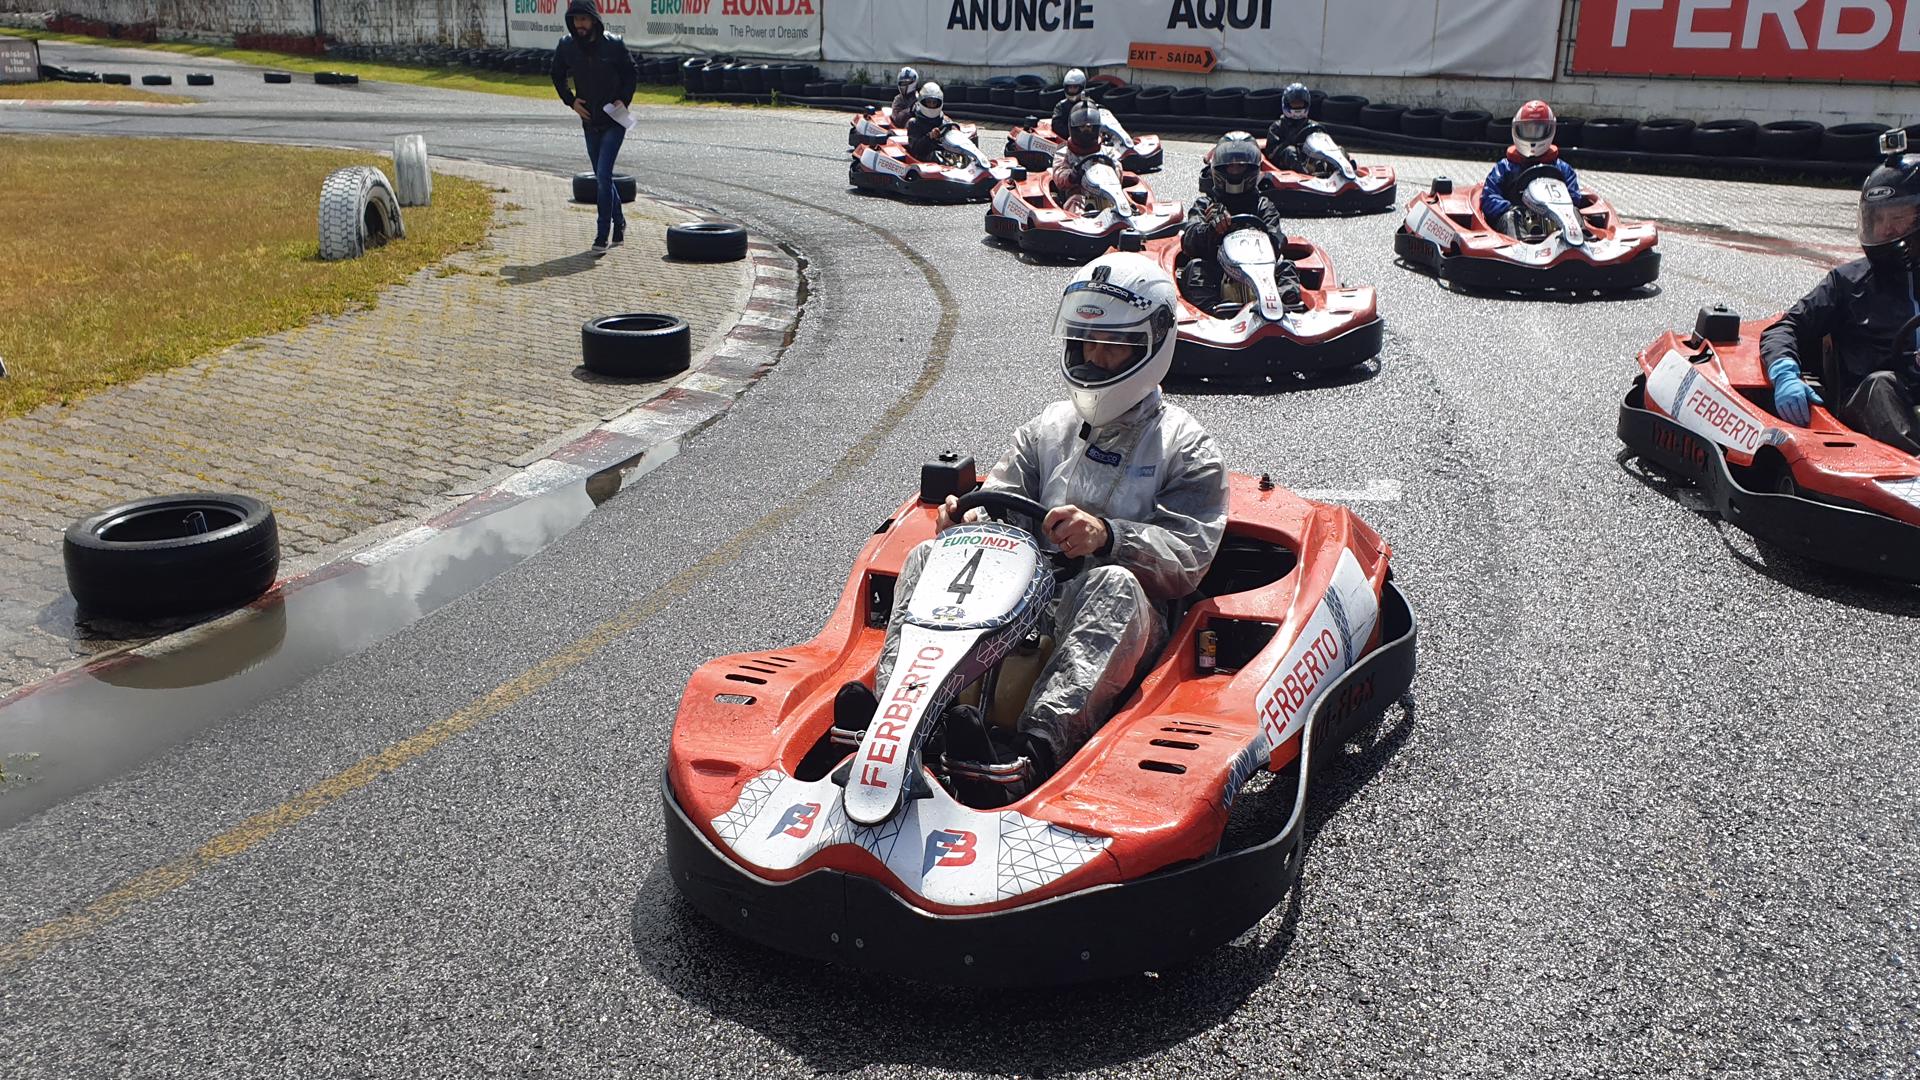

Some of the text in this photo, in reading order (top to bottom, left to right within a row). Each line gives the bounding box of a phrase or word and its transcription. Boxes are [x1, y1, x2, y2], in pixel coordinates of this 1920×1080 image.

[515, 0, 558, 14] EUROINDY
[651, 0, 709, 15] EUROINDY
[722, 0, 814, 16] HONDA
[947, 0, 1094, 32] ANUNCIE
[1167, 0, 1271, 32] AQUI
[730, 24, 744, 38] The
[746, 25, 767, 39] Power
[778, 26, 809, 40] Dreams
[1611, 0, 1920, 52] FERB
[10, 57, 25, 66] the
[1130, 49, 1157, 60] EXIT
[1167, 51, 1202, 65] SAÍDA
[4, 64, 32, 73] future
[1544, 183, 1562, 200] 15
[1686, 389, 1760, 451] FERBERTO
[942, 535, 1020, 550] EUROINDY
[946, 548, 985, 605] 4
[1259, 628, 1340, 747] FERBERTO
[860, 645, 945, 789] FERBERTO
